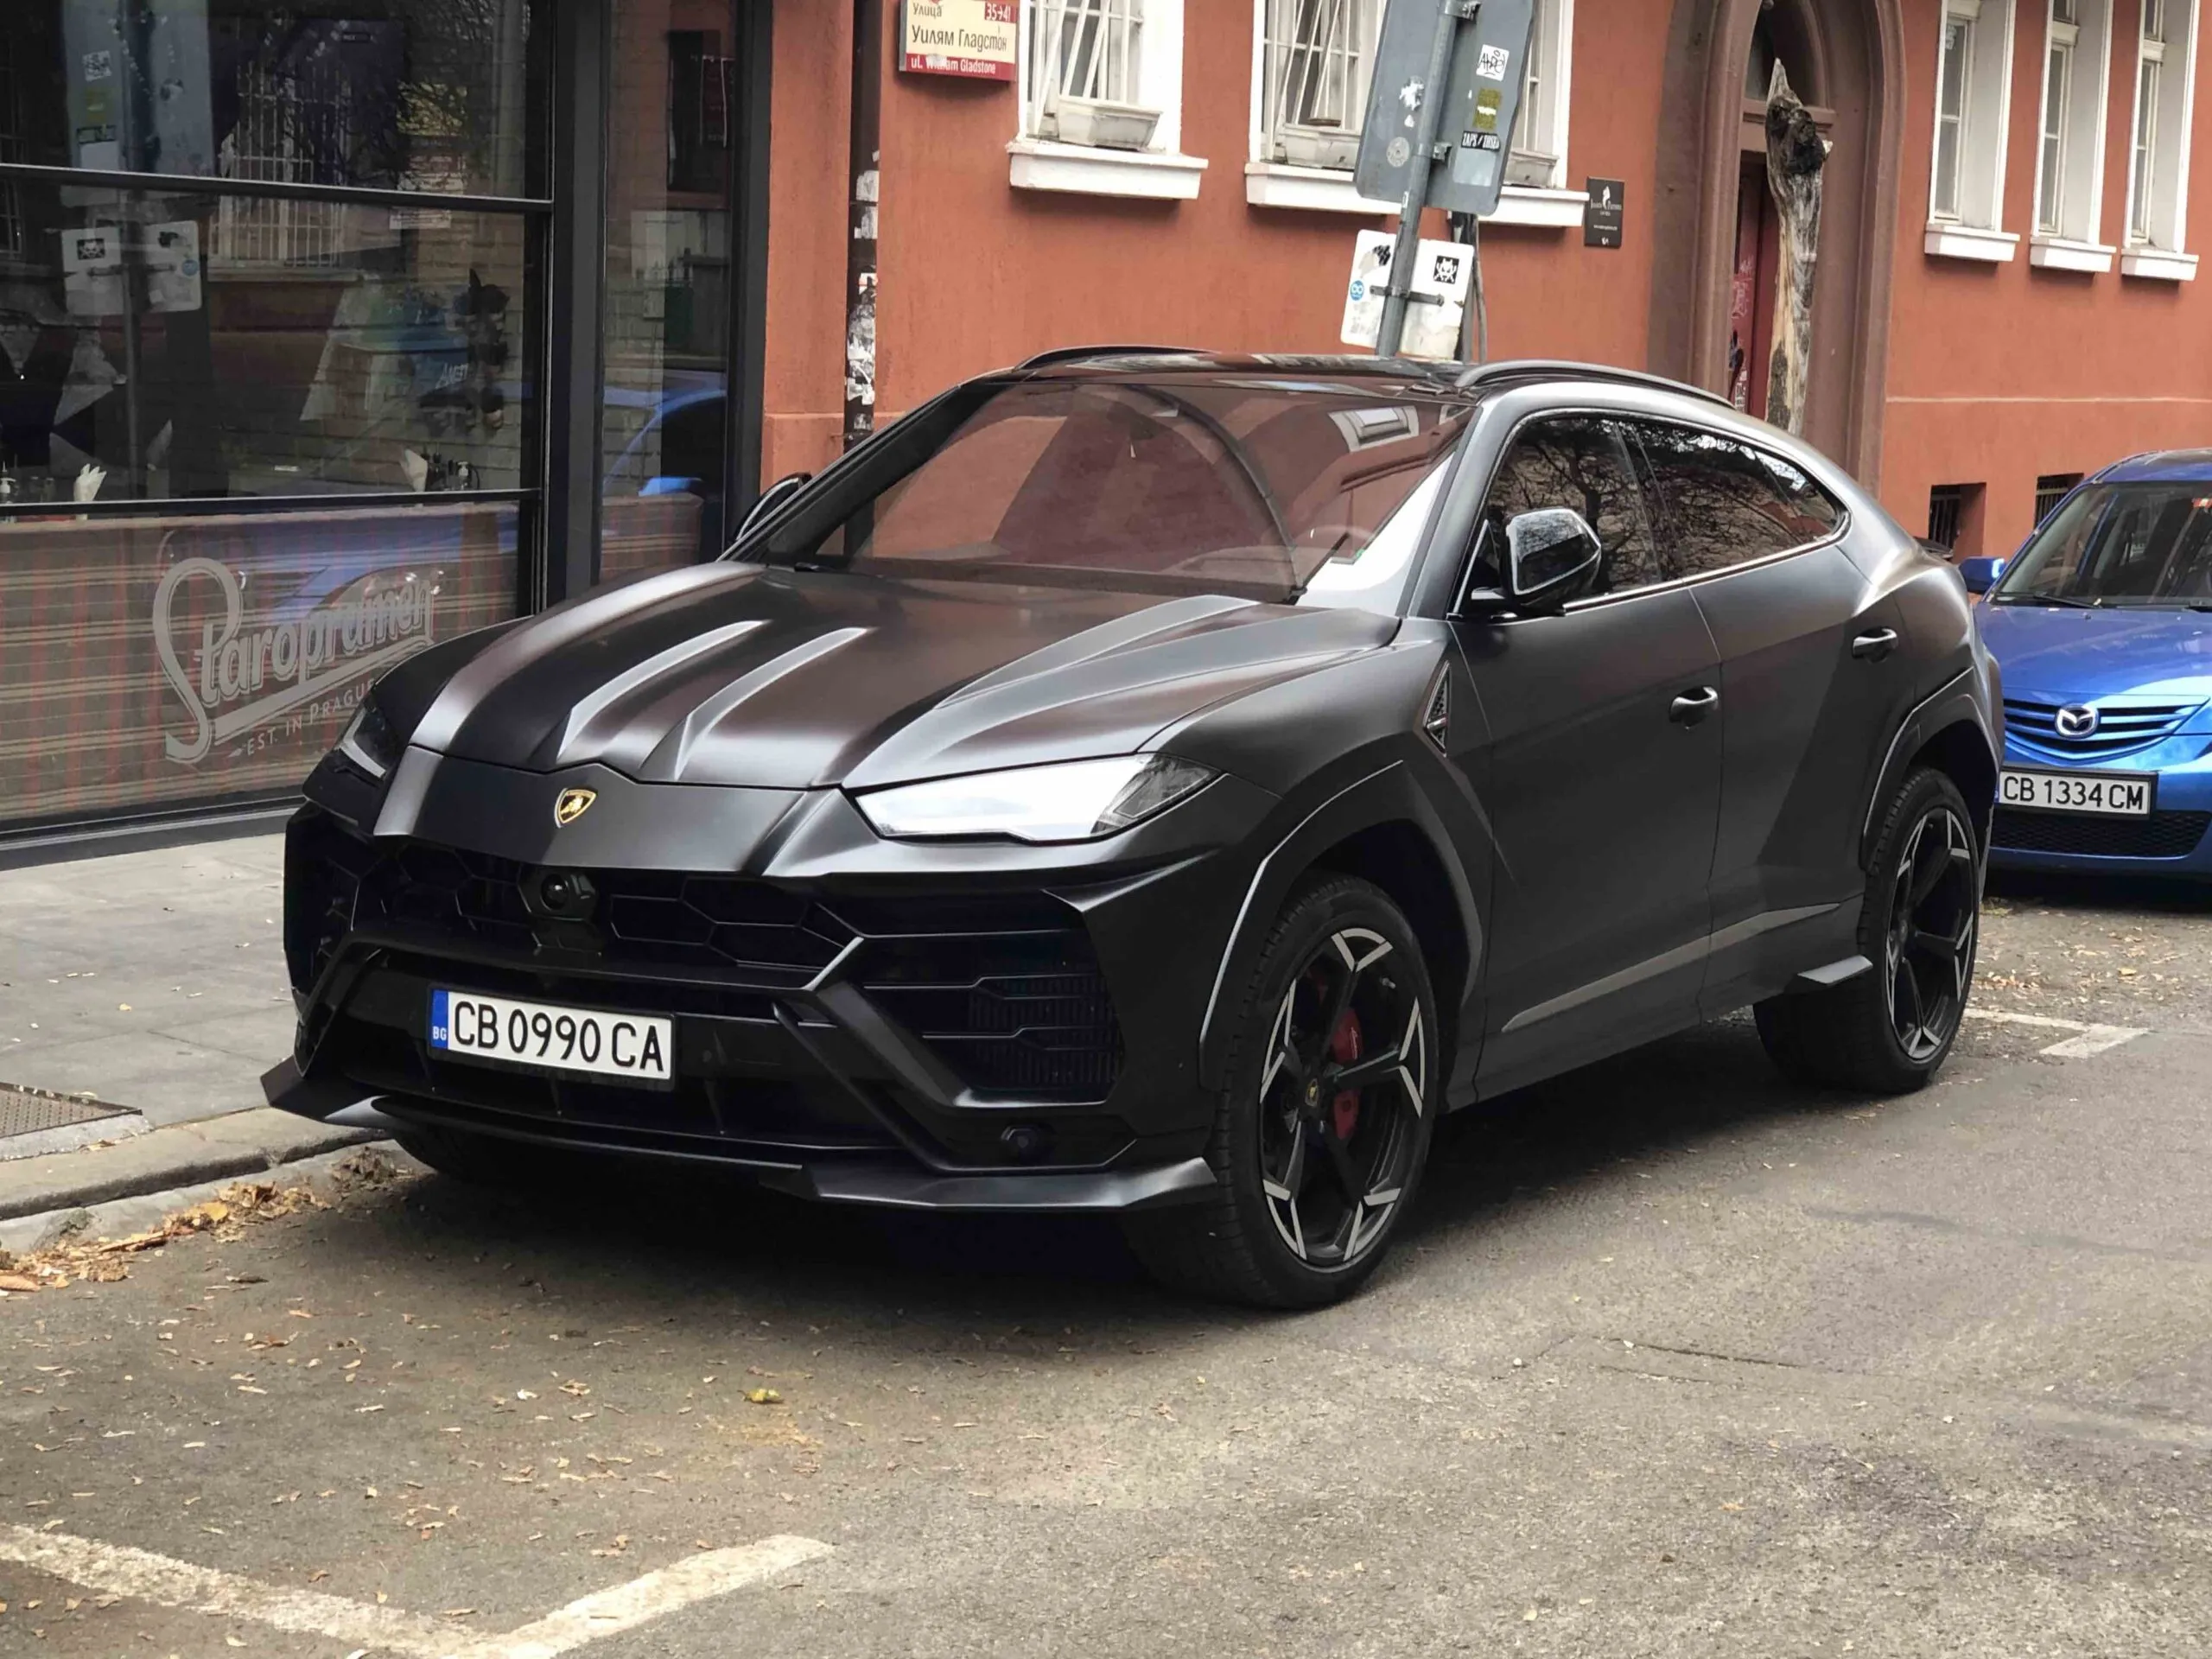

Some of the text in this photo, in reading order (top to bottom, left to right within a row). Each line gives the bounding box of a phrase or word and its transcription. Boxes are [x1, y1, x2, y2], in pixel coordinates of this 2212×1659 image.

[912, 24, 954, 47] Уилям
[960, 59, 996, 74] Gladstone
[153, 556, 432, 764] Staropramen
[247, 727, 278, 756] EST.
[286, 715, 302, 736] IN
[2003, 776, 2144, 810] CB 1334 CM
[432, 1026, 447, 1040] BG
[454, 1001, 664, 1071] CB 0990 CA
